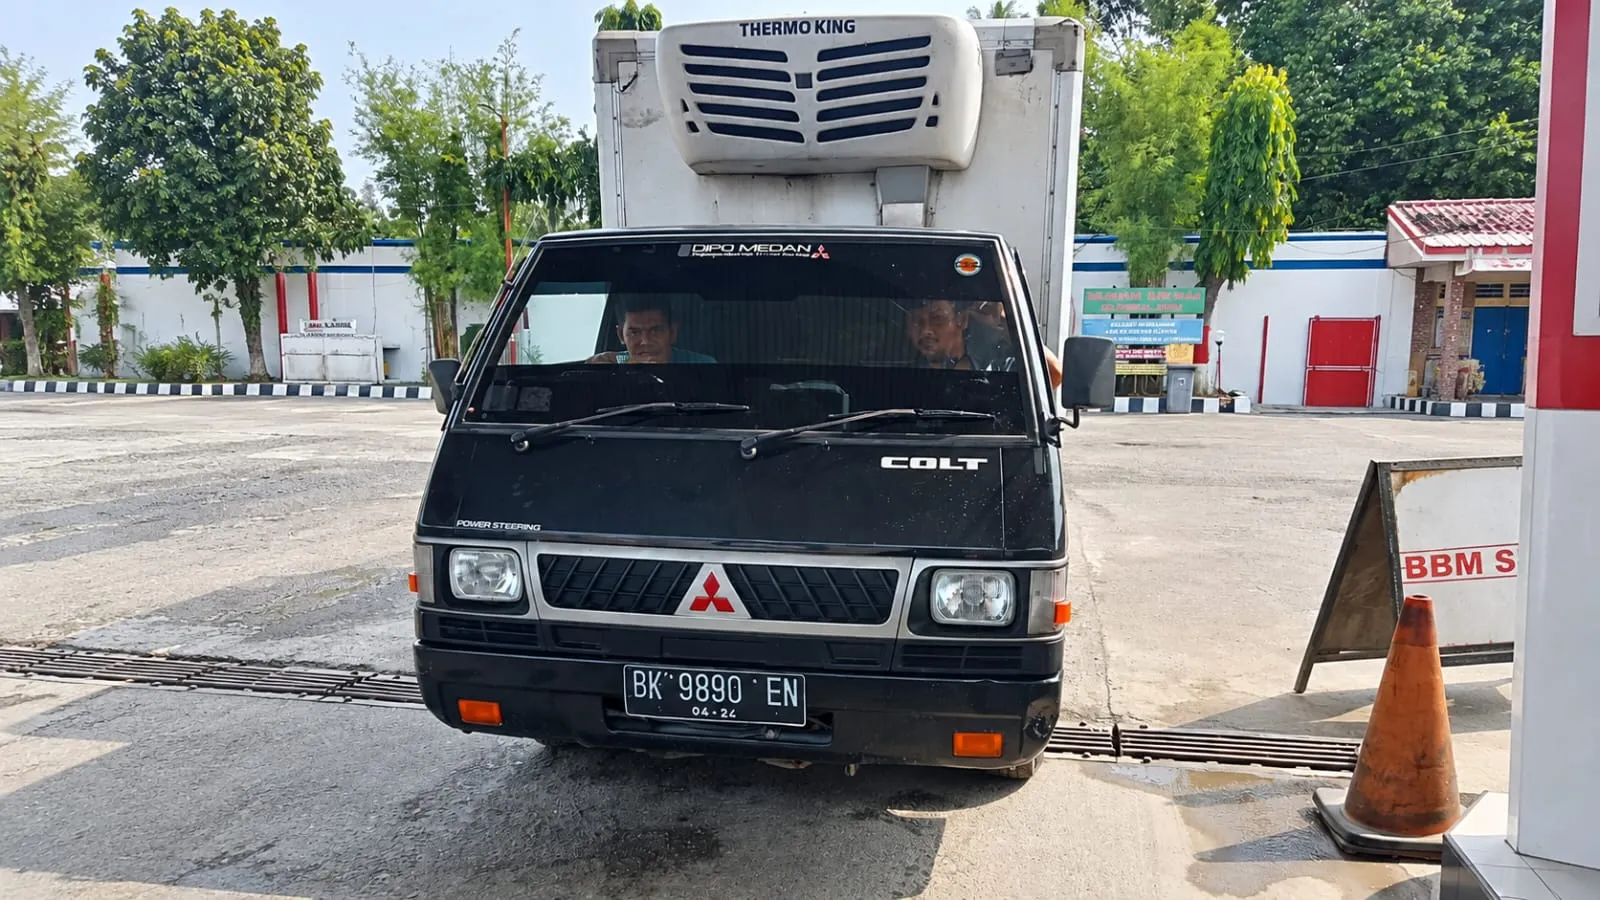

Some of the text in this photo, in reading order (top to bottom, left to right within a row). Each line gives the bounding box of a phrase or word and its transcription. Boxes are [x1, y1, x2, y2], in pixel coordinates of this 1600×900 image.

[740, 19, 855, 37] THERMO KING
[692, 244, 811, 253] DIPO MEDAN
[881, 456, 988, 470] COLT
[456, 520, 541, 531] POWER STEERING
[1405, 551, 1483, 579] BBM
[633, 670, 798, 707] BK 9890 EN
